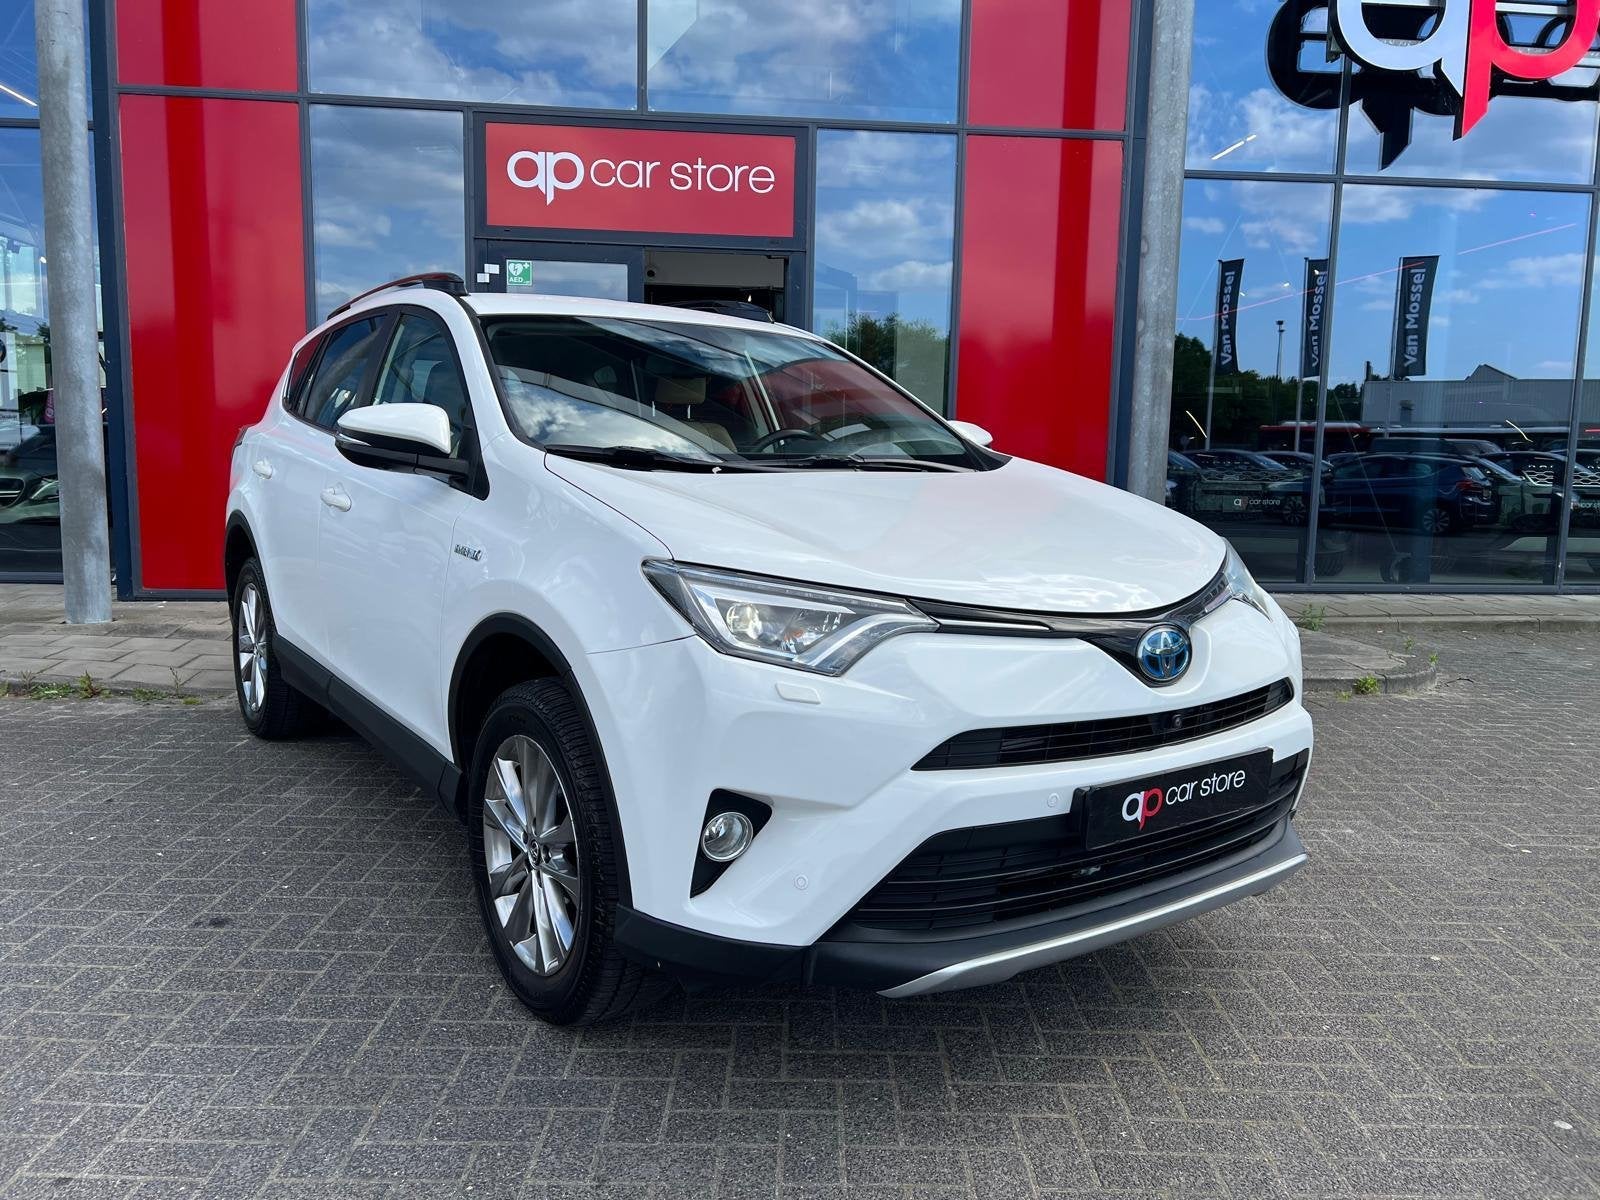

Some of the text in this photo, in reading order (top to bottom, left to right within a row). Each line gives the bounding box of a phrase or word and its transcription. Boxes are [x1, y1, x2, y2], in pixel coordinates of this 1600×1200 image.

[507, 150, 775, 205] ap car store
[1220, 271, 1236, 366] Van Mossel
[1403, 268, 1426, 368] Van Mossel
[1122, 770, 1246, 830] ap car store
